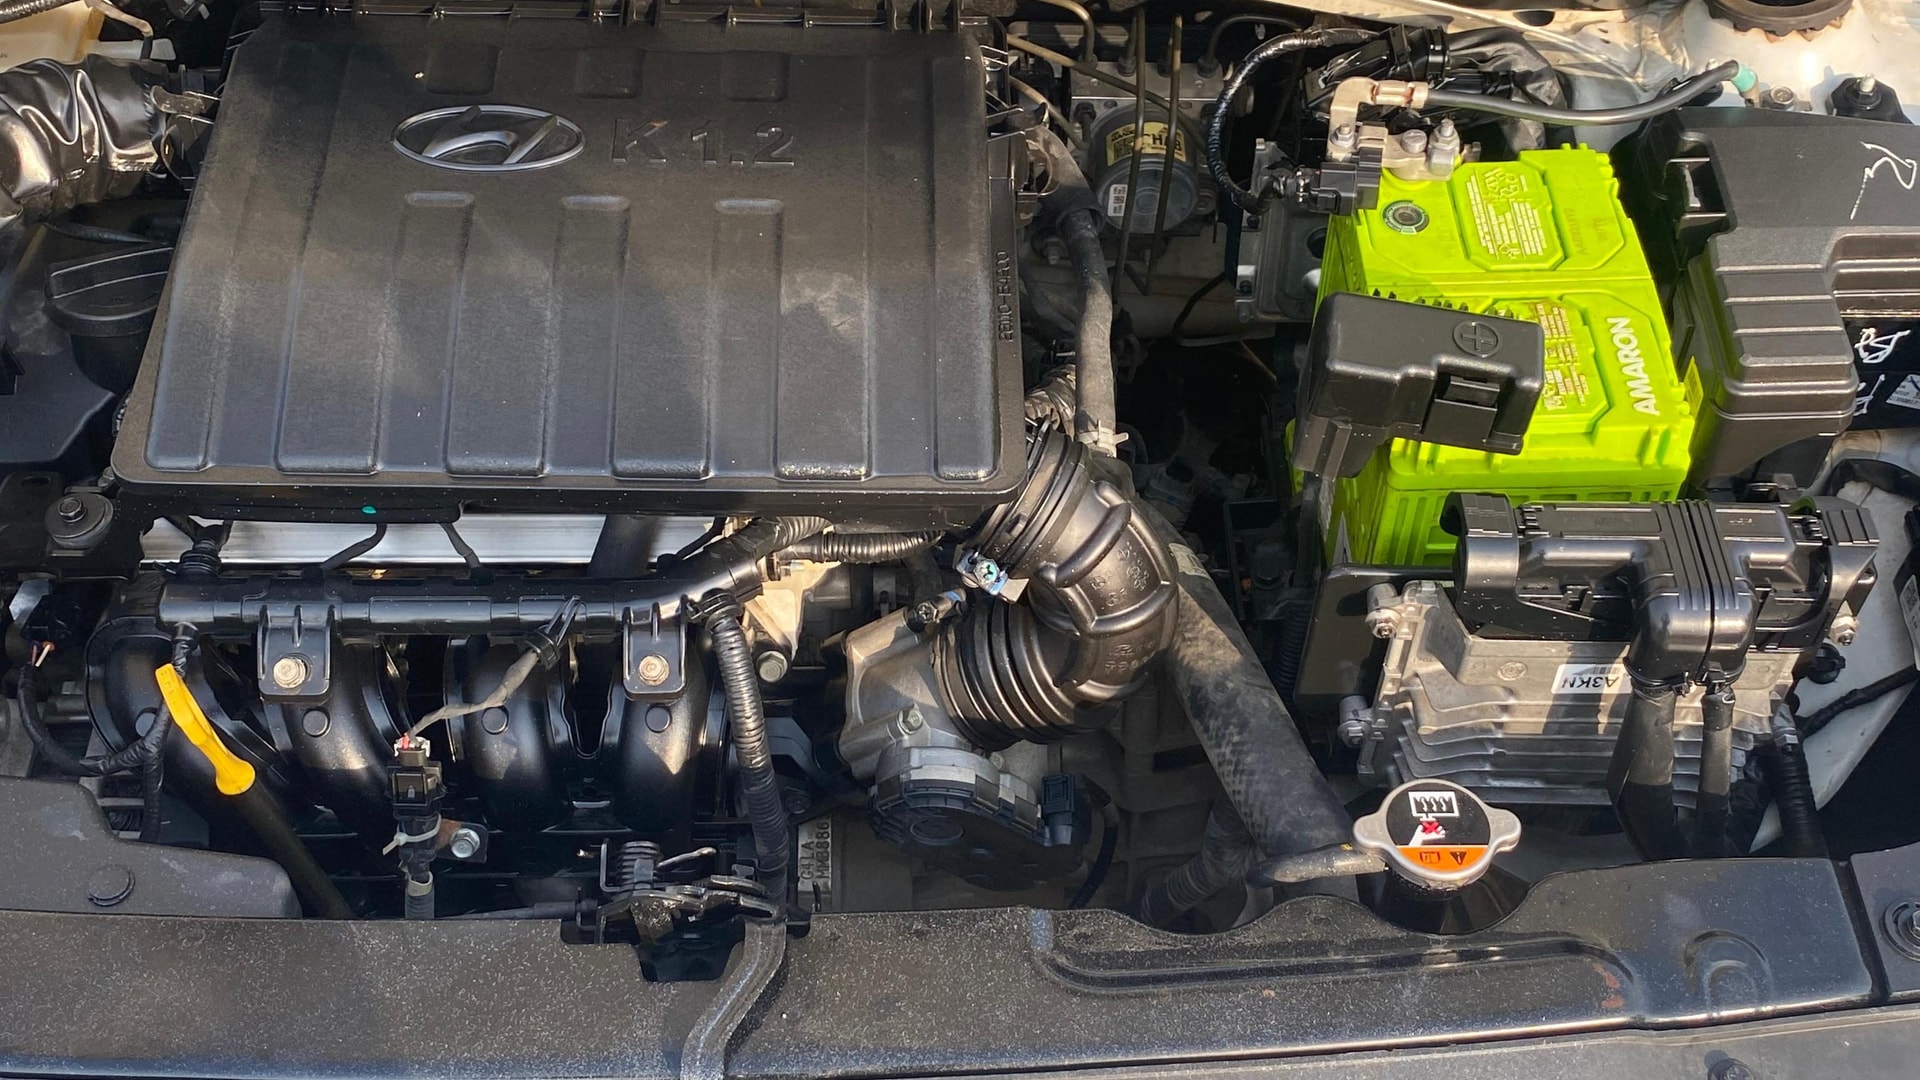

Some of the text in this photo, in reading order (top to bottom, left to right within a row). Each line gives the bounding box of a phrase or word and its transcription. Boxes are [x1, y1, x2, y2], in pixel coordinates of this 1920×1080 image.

[612, 118, 796, 167] K 1.2
[1606, 316, 1661, 416] AMARON
[1561, 676, 1619, 689] A3KN
[801, 841, 815, 880] G4LA
